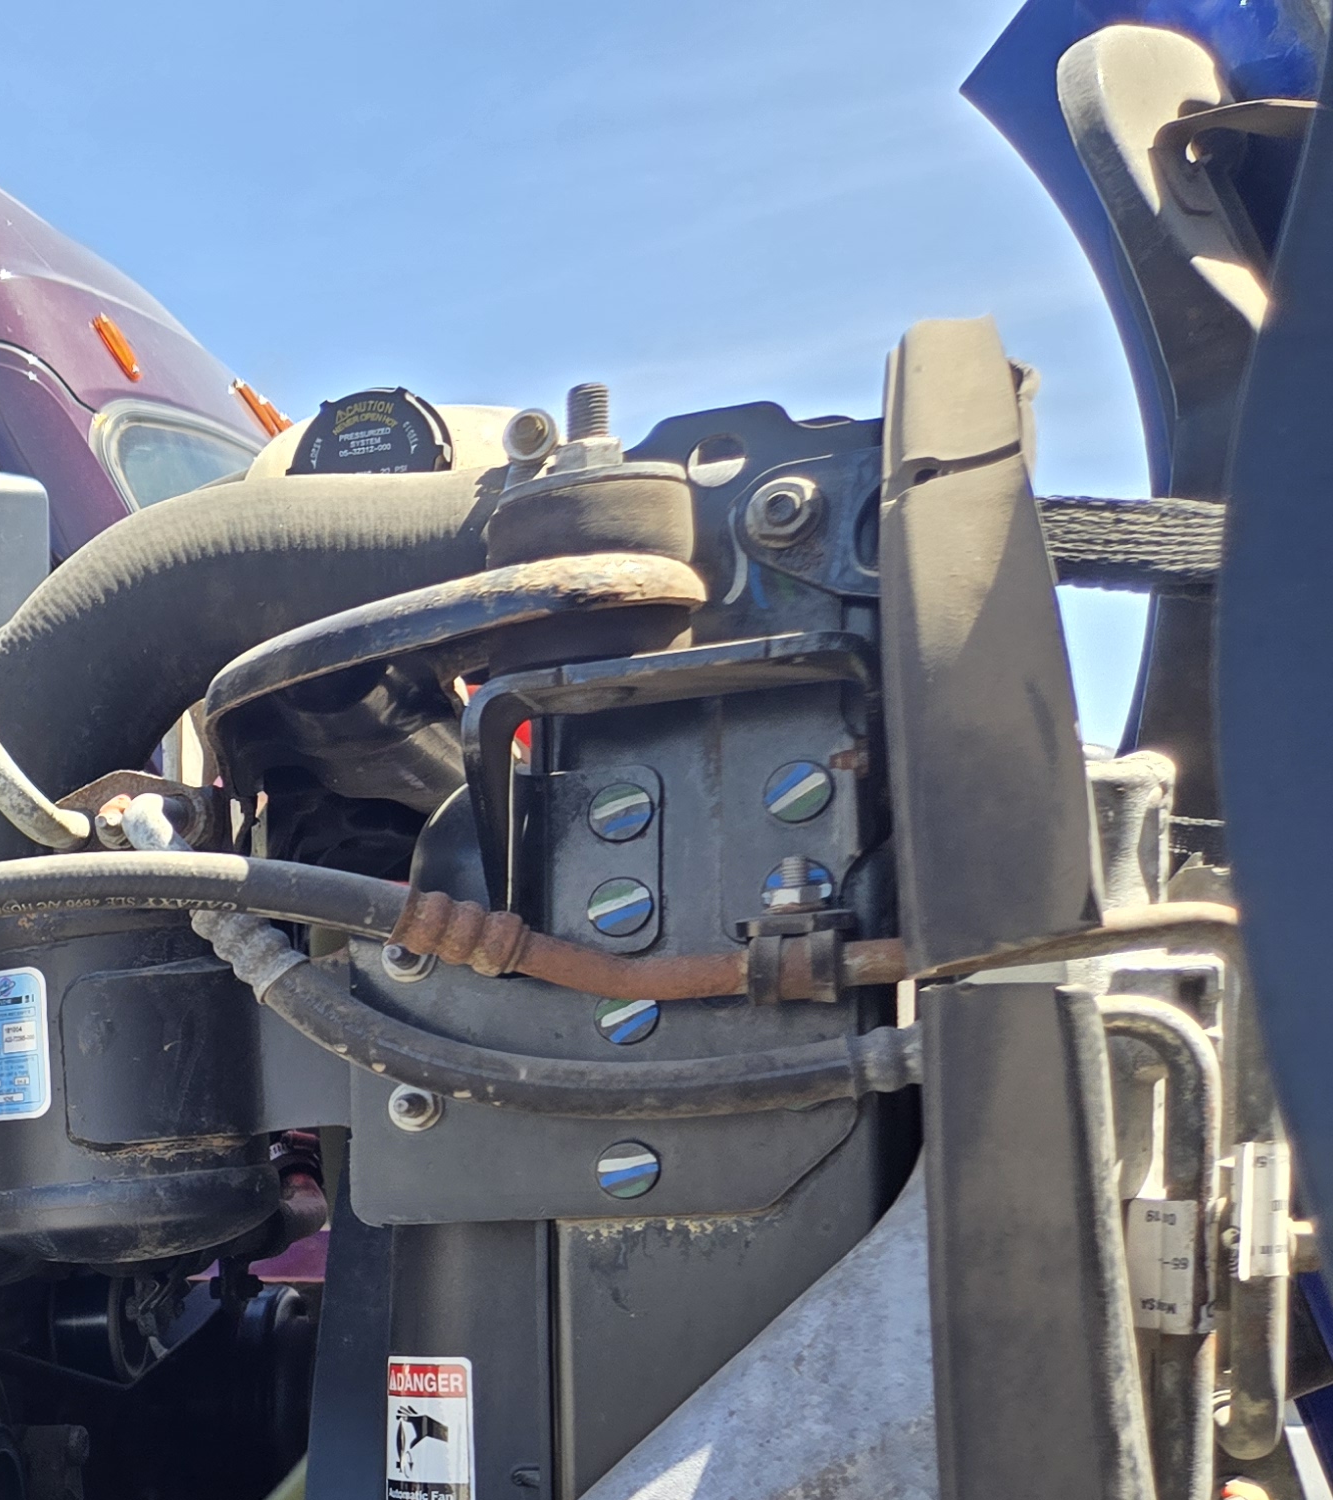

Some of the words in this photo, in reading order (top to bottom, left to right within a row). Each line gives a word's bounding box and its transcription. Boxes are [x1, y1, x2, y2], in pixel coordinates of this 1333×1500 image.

[347, 400, 395, 414] CAUTION
[333, 416, 359, 435] NEVER
[360, 412, 382, 422] OPEN
[339, 427, 391, 442] PRESSURIZED
[350, 437, 381, 448] SYSTEM
[146, 897, 237, 911] GALAXY
[397, 1372, 463, 1392] DANGER
